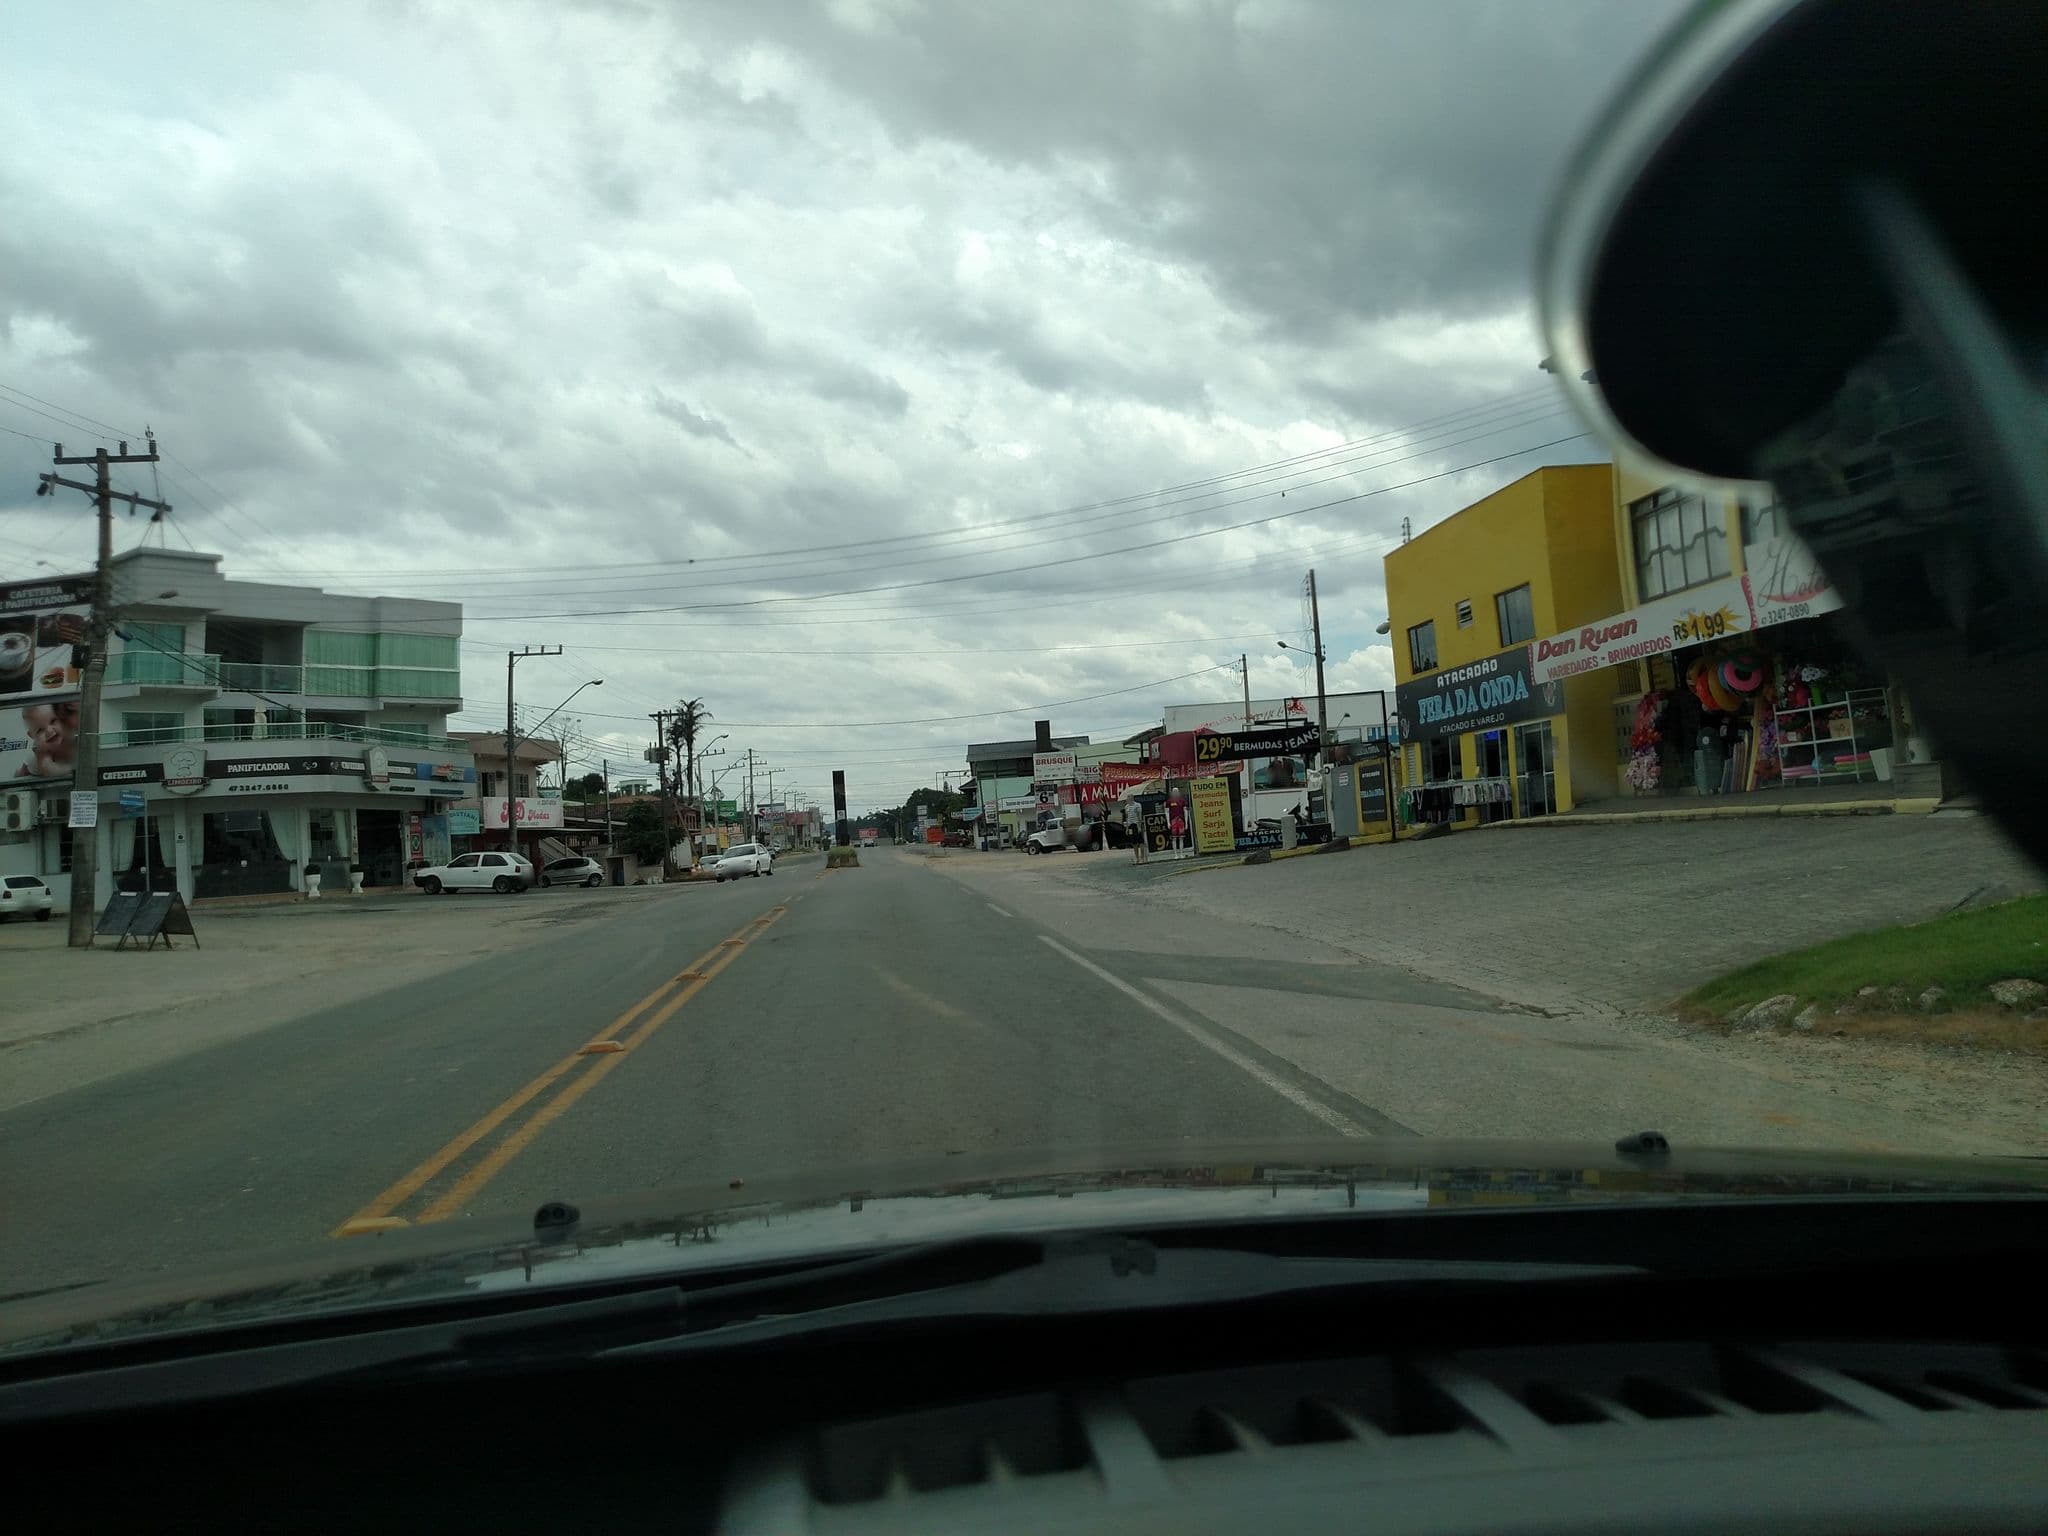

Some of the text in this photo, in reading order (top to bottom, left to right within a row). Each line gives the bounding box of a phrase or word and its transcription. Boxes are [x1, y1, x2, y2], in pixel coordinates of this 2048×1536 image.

[1672, 623, 1689, 641] R$
[1537, 618, 1638, 662] Dan Ruan
[1546, 656, 1599, 678] VARIEDADES
[1607, 635, 1673, 664] BRINQUEDOS
[1437, 659, 1498, 688] ATACADÃO
[1418, 670, 1529, 724] FERA DA ONDA
[1439, 712, 1504, 735] ATACADO E VAREJO
[1234, 741, 1282, 751] BERMUDAS
[1036, 757, 1073, 766] BRUSQUE
[227, 762, 290, 773] PANIFICADORA
[103, 770, 147, 780] CAFETERIA
[168, 778, 202, 786] LIMOEIRO
[1193, 782, 1213, 790] TUDO
[1193, 791, 1227, 799] Bermudas
[1199, 800, 1224, 808] Jeans
[1203, 809, 1221, 818] Surf
[1203, 820, 1225, 829] Sarja
